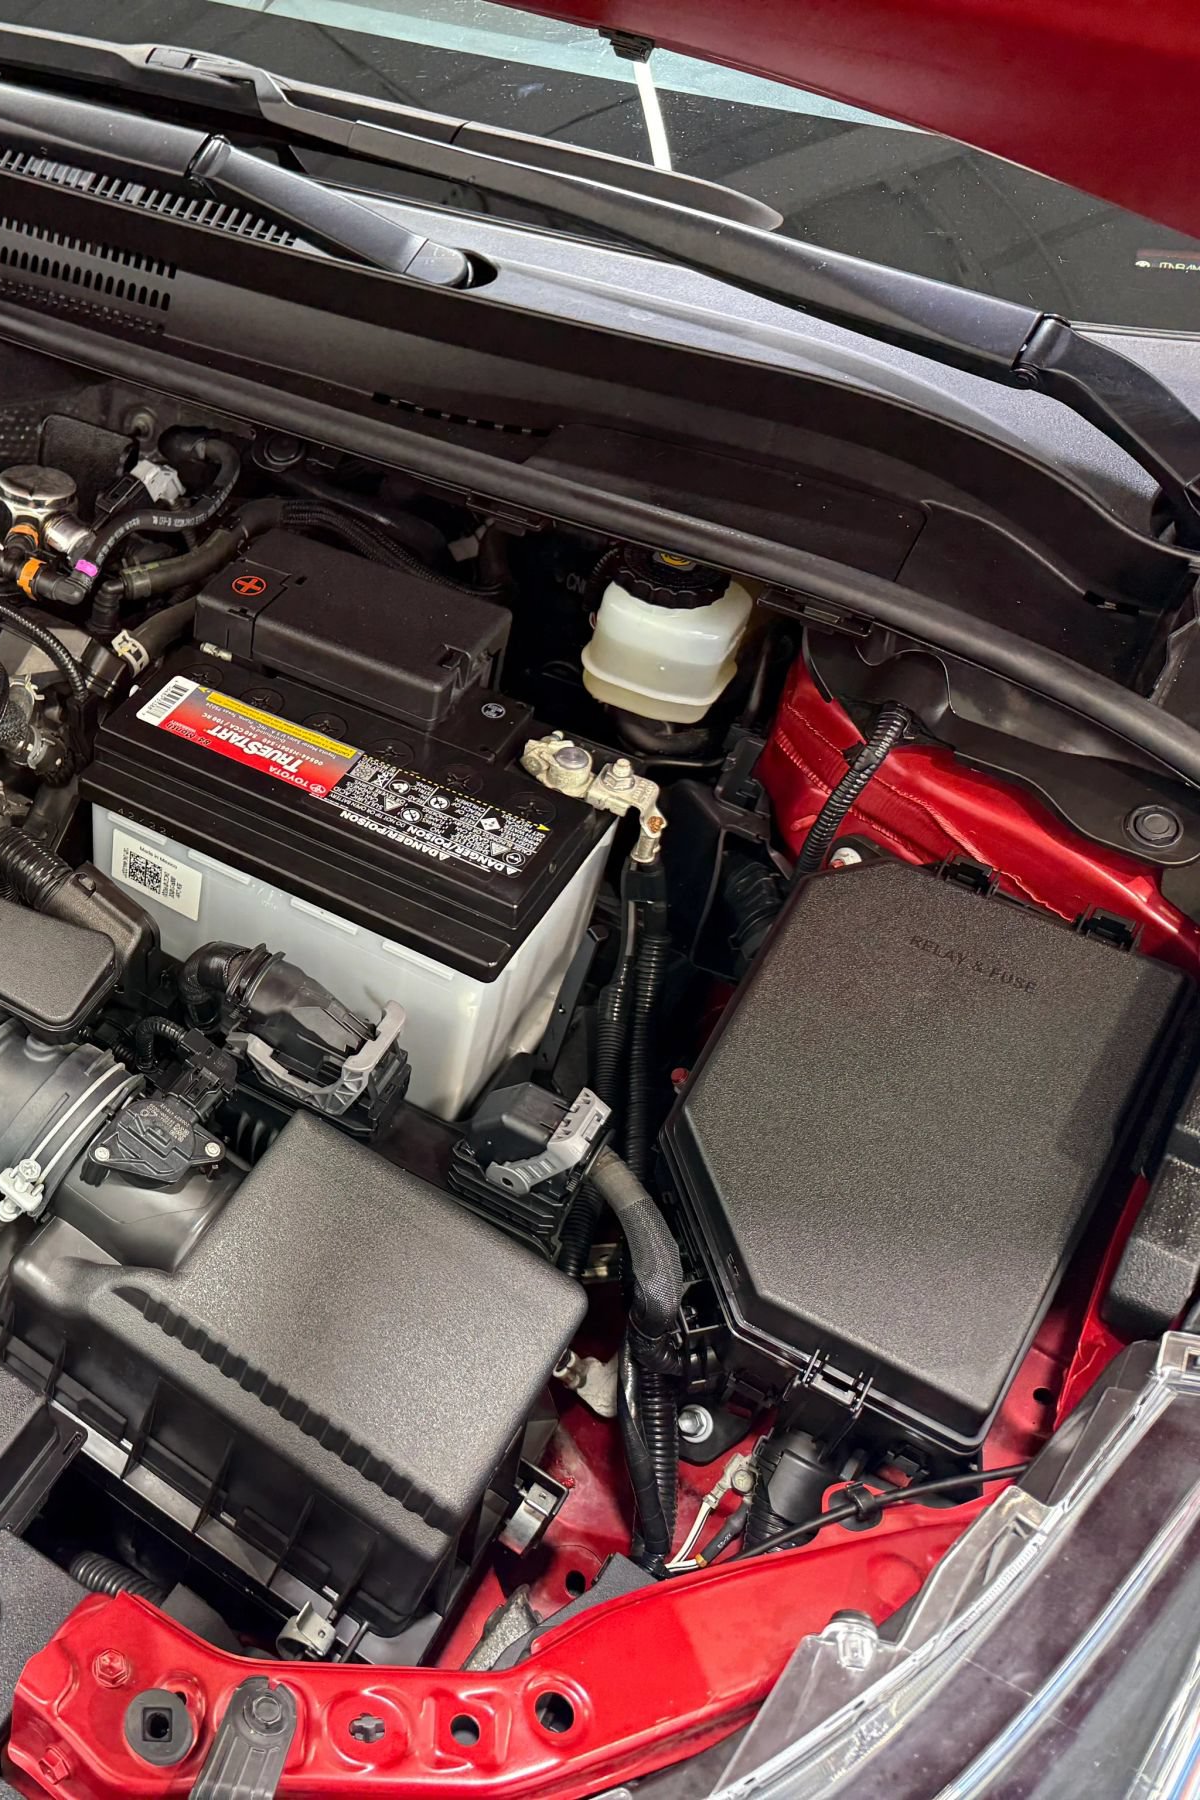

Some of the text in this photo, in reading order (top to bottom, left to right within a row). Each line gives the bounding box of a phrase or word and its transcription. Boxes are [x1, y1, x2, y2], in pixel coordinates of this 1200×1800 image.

[221, 708, 237, 717] Texas
[164, 722, 211, 745] 84 Month
[228, 723, 244, 733] CCA
[254, 727, 286, 743] Distributed
[285, 735, 301, 744] Sales
[300, 740, 318, 751] Motor
[204, 723, 303, 773] TRUESTART
[317, 748, 337, 759] Toyota
[356, 758, 394, 776] BATTERY MUST
[361, 755, 388, 769] RECYCLED
[267, 765, 309, 787] TOYOTA
[345, 780, 378, 797] BLINDNESS
[345, 785, 379, 802] CAN CAUSE
[373, 787, 395, 800] SEVERE
[327, 792, 352, 804] BATTERY
[332, 785, 384, 810] SULFURIC ACID
[394, 796, 406, 804] OR
[406, 794, 425, 804] READ
[349, 801, 367, 811] OPEN
[450, 800, 483, 817] REACH OF
[382, 815, 396, 823] NOT
[421, 806, 448, 821] SMOKING
[424, 813, 445, 825] FLAMES
[453, 807, 479, 821] OUT OF
[458, 815, 476, 825] KEEP
[420, 817, 442, 828] SPARKS
[428, 825, 442, 834] NO
[503, 818, 546, 839] GET MEDICAL
[514, 818, 533, 829] HELP
[338, 809, 439, 857] DANGER/POISON
[453, 825, 490, 843] GASES CAN
[454, 831, 490, 849] EXPLOSIVE
[481, 831, 513, 847] BLINDNESS
[497, 826, 540, 847] IMMEDIATELY
[524, 832, 543, 842] WITH
[405, 825, 505, 871] DANGER/POISON
[465, 841, 490, 854] SHIELD
[499, 832, 536, 850] FLUSH EYES
[511, 844, 532, 856] CAUSE
[909, 935, 1037, 994] RELAY & FUSE
